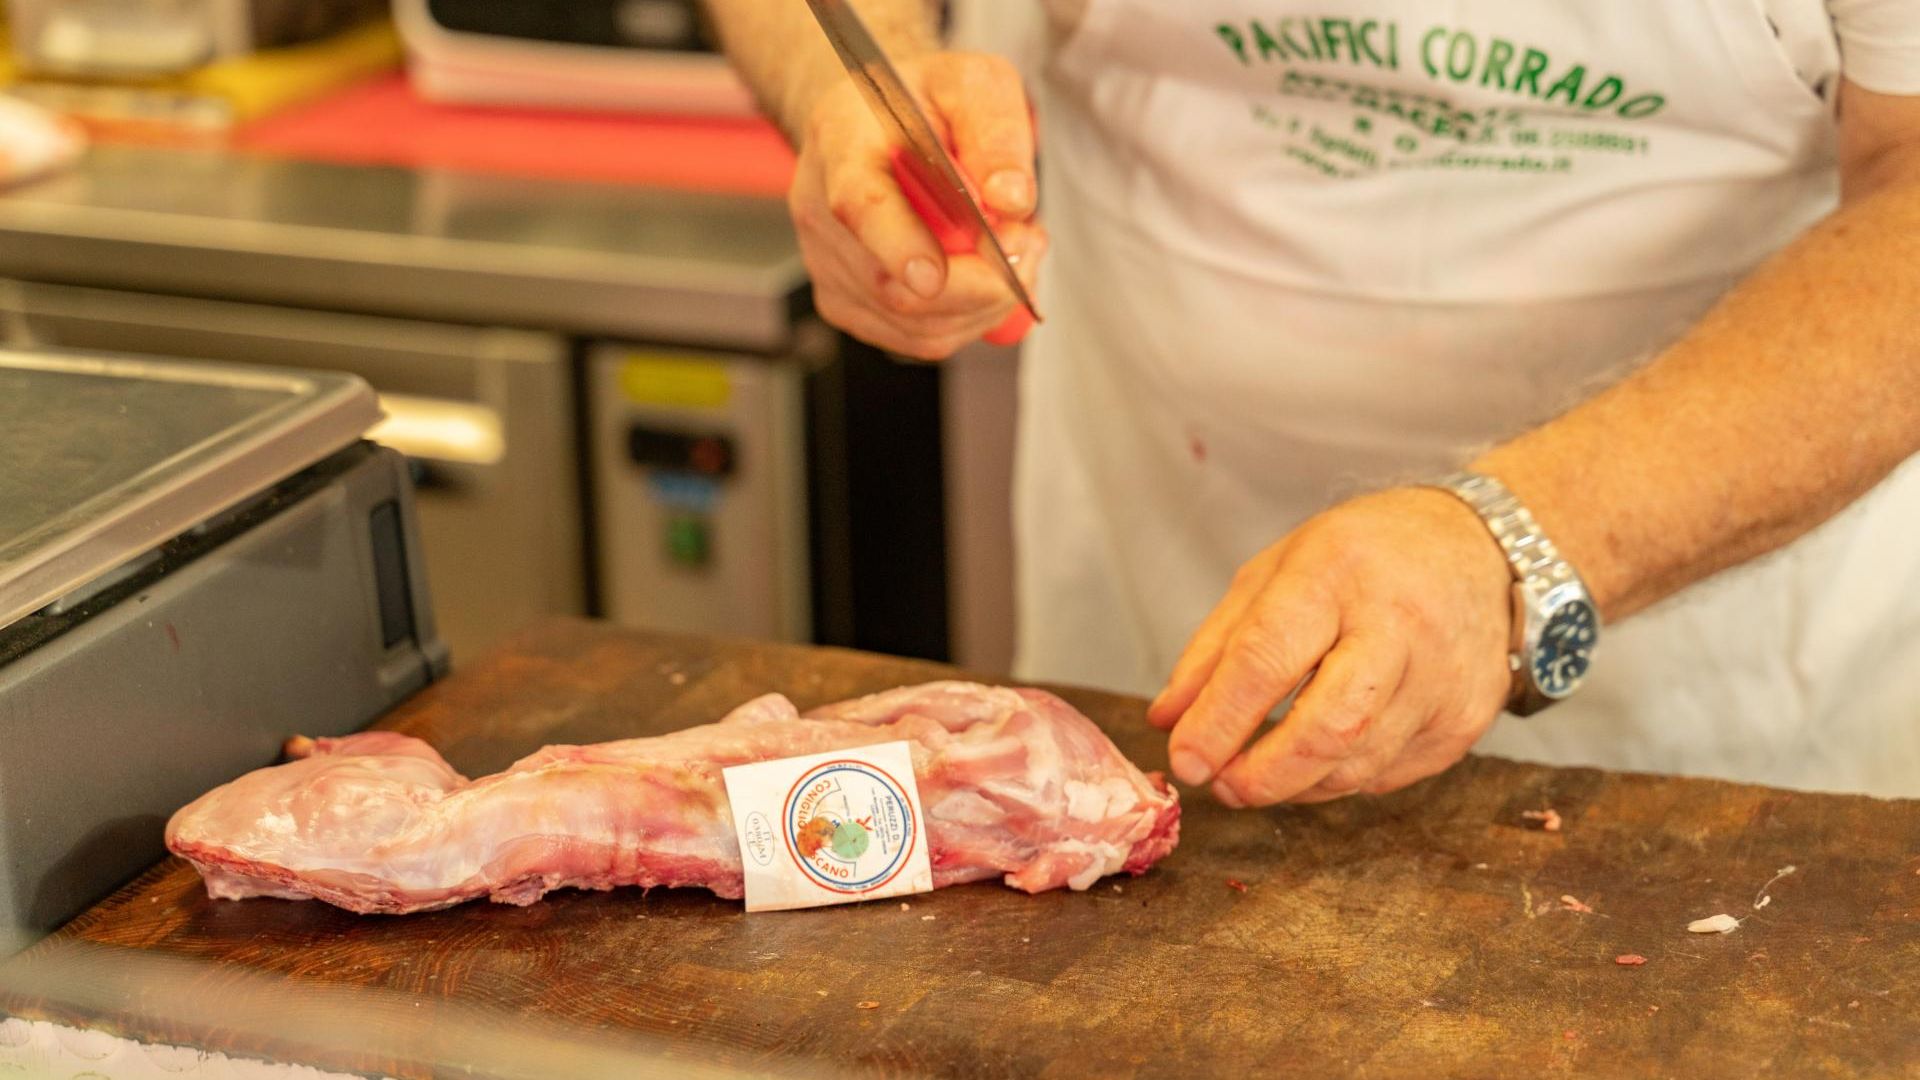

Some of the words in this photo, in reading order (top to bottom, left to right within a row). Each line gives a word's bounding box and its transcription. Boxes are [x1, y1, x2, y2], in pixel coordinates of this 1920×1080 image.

[1215, 18, 1399, 71] PACIFICI
[1421, 27, 1667, 119] CORRADO
[797, 779, 831, 829] CONIGLIO
[886, 795, 898, 834] PERUZZI
